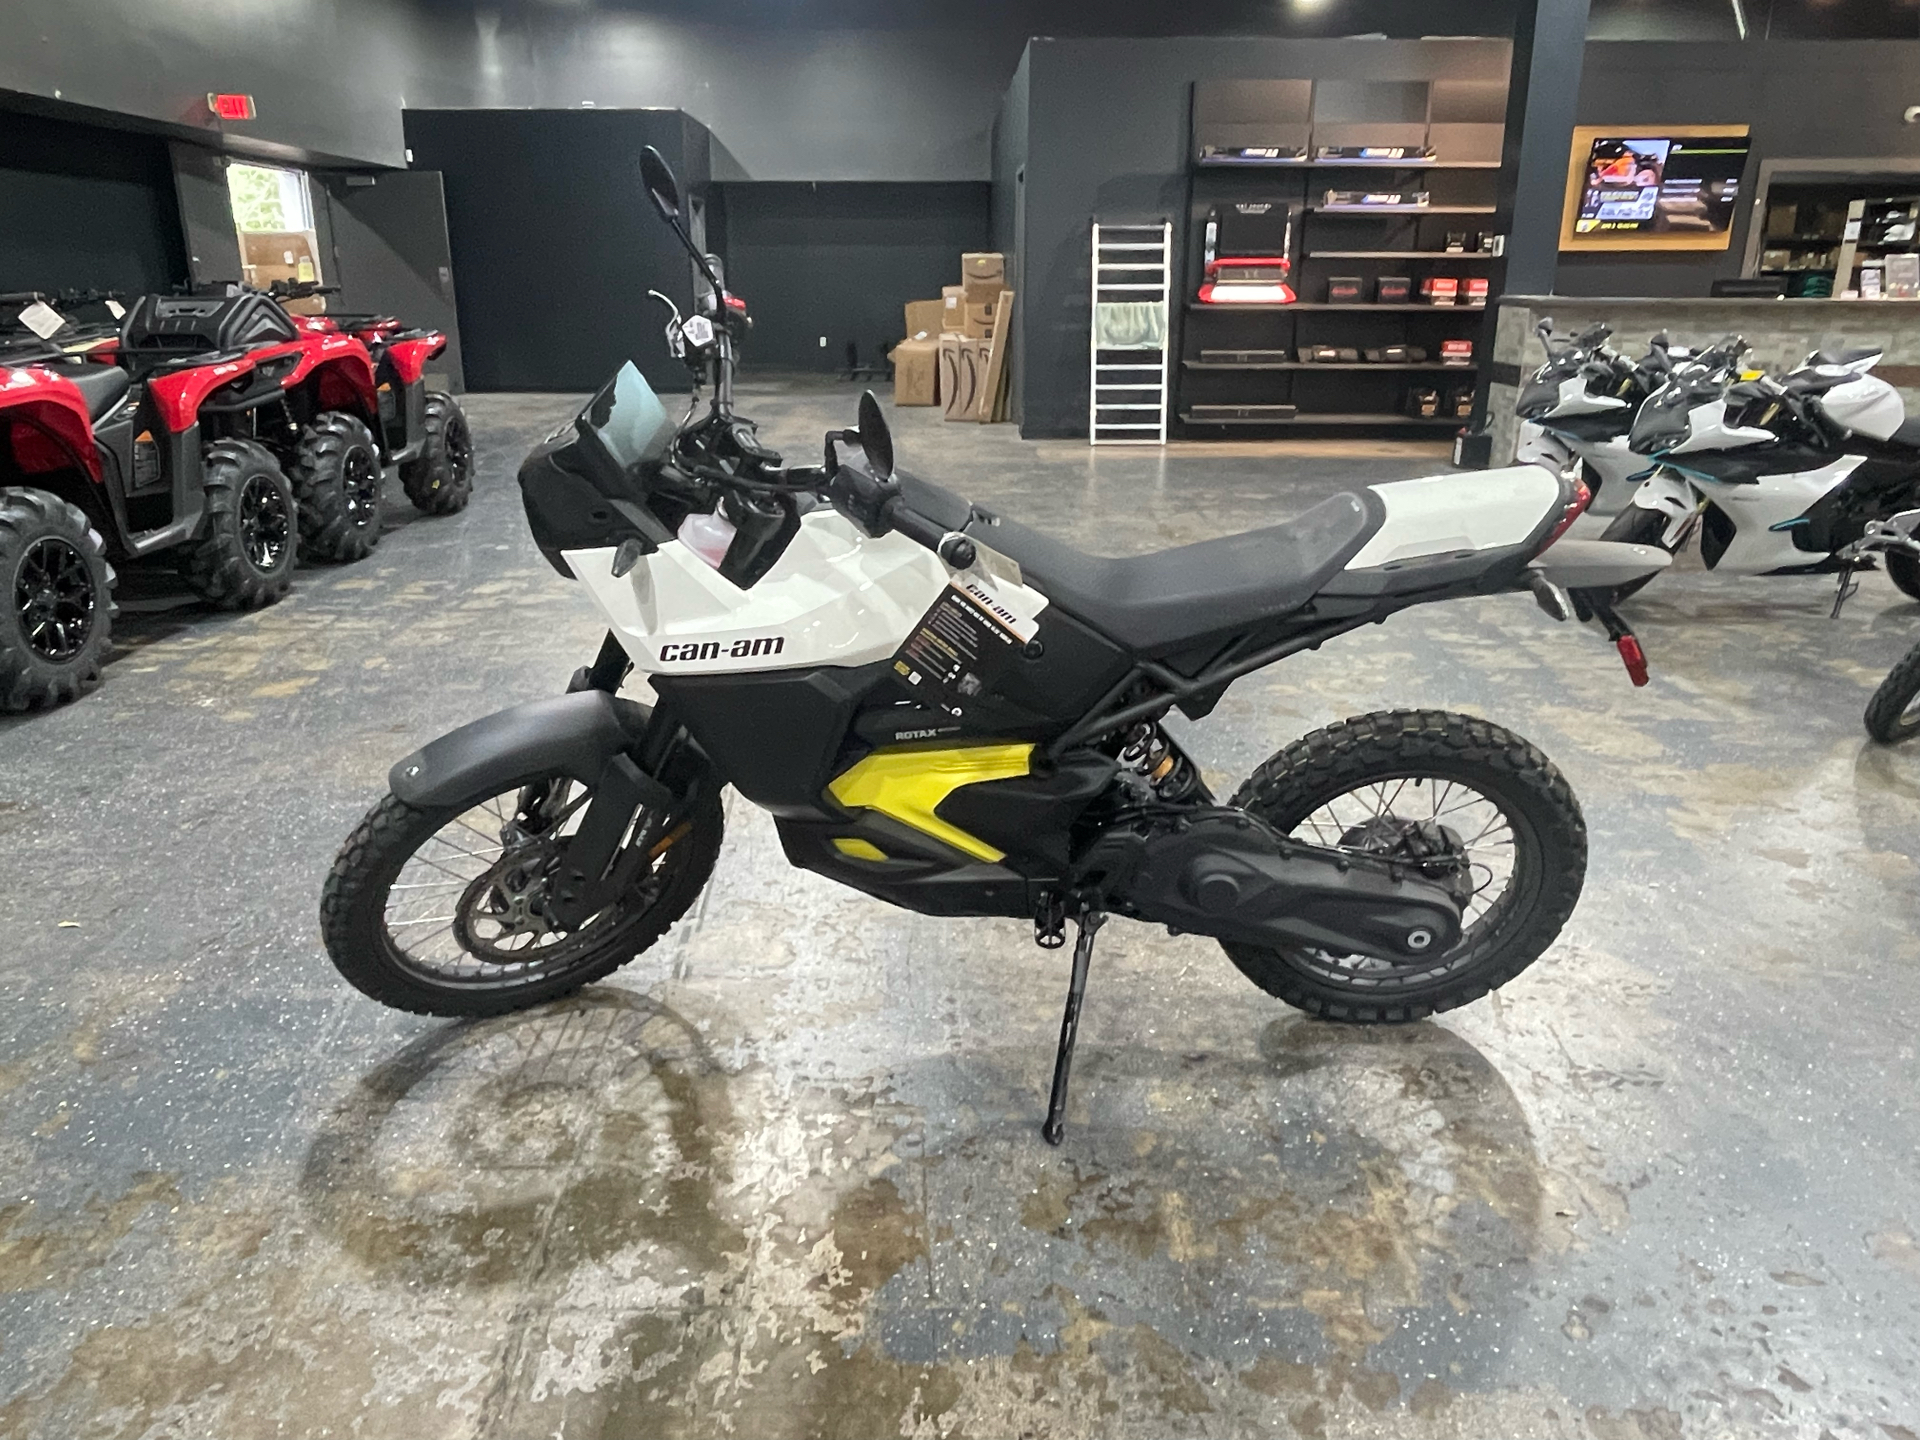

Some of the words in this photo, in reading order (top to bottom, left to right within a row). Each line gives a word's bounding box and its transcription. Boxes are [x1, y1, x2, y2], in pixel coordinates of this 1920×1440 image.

[965, 583, 1018, 625] can-am
[659, 636, 785, 662] can-am
[894, 728, 938, 741] ROTAX
